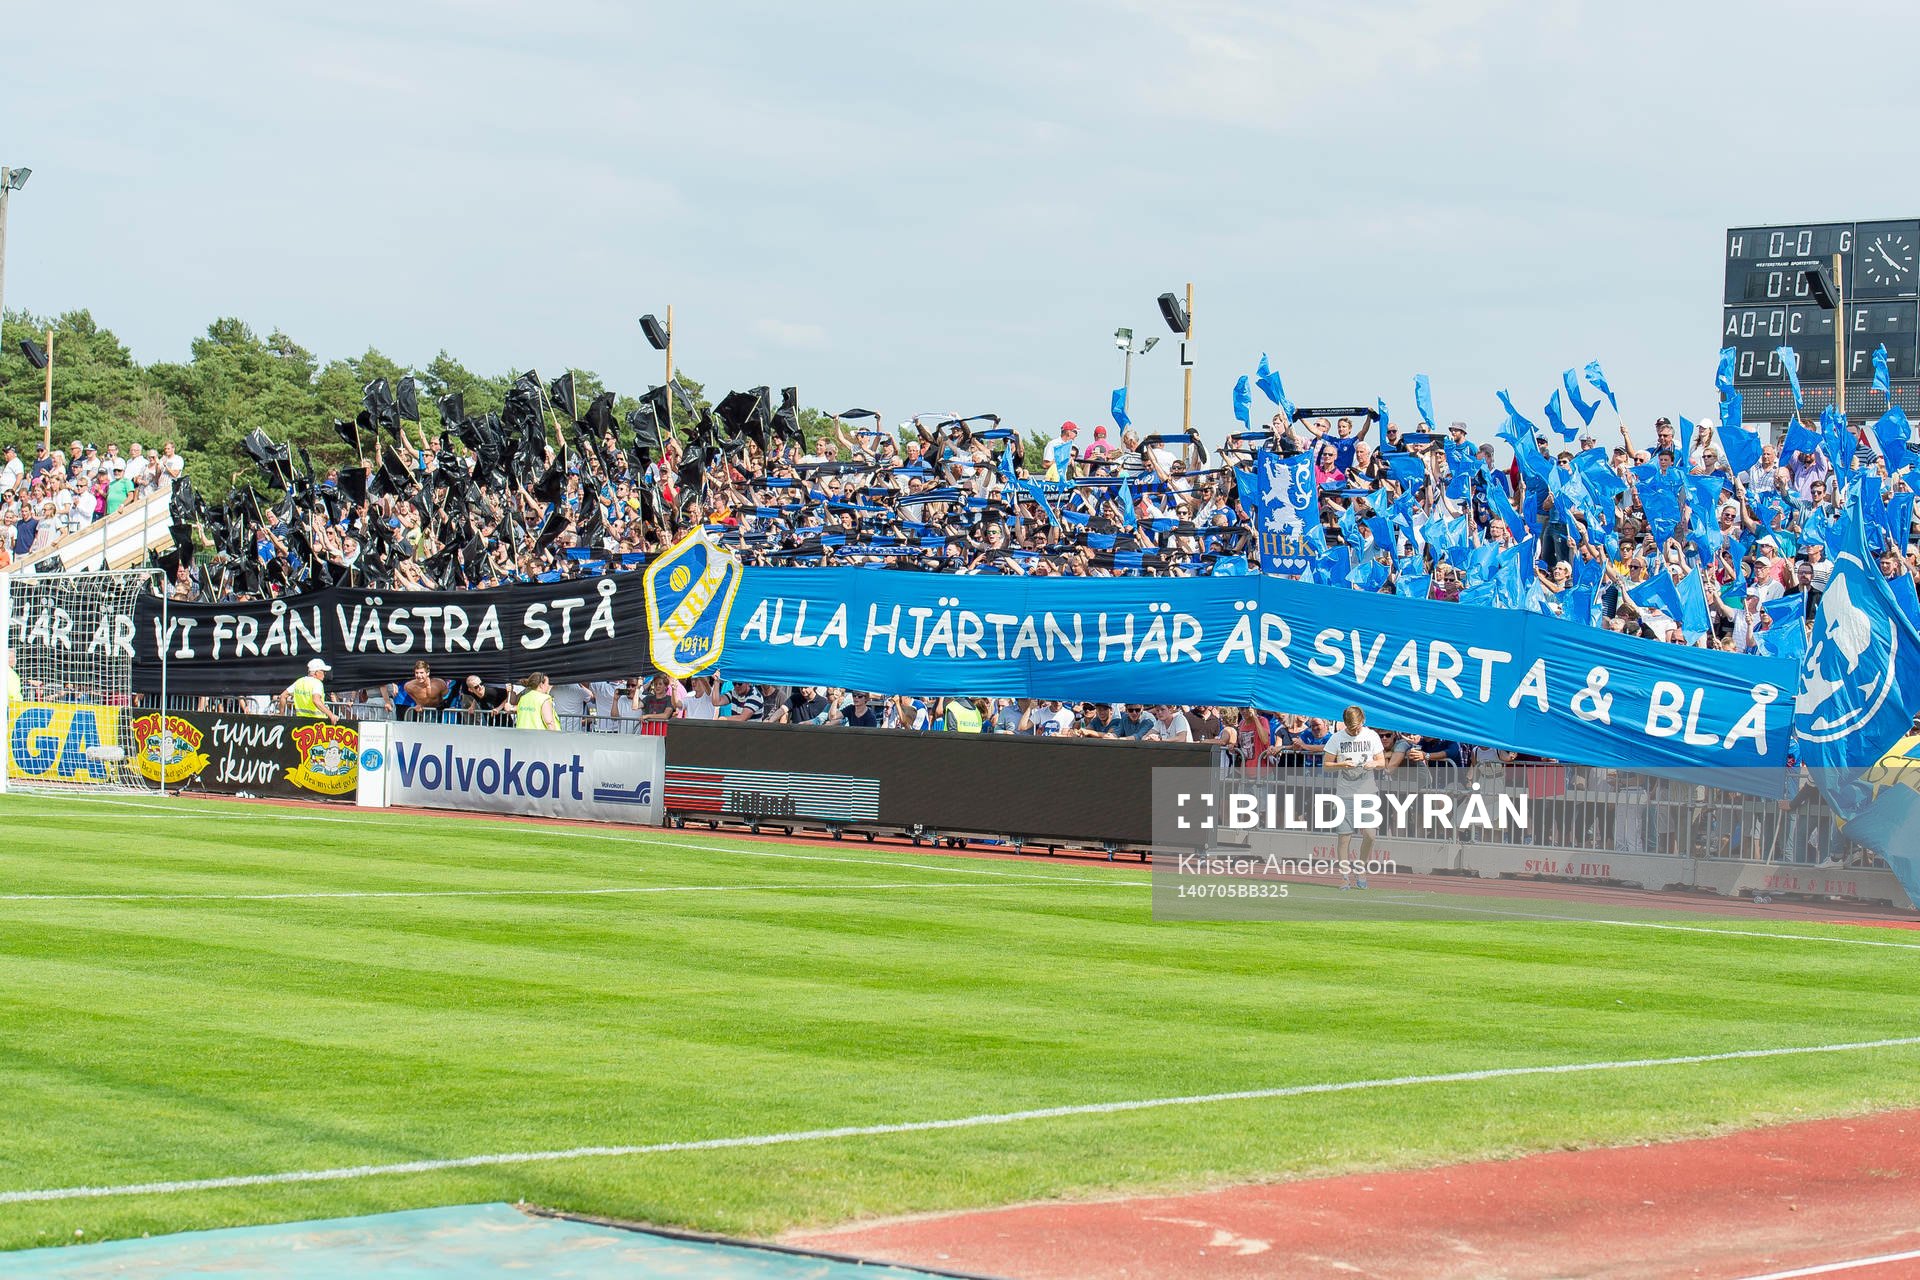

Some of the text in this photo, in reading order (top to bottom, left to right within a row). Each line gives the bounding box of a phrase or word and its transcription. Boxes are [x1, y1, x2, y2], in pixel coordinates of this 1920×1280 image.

[1730, 231, 1851, 258] H 0-0 G
[1725, 315, 1738, 335] A
[1790, 312, 1802, 334] C
[1854, 310, 1868, 331] E
[1852, 350, 1866, 372] F
[1262, 532, 1316, 557] HBK
[88, 604, 136, 657] ÄR
[153, 616, 198, 660] VI
[212, 600, 322, 660] FRÅN
[337, 596, 504, 652] VÄSTRA
[520, 579, 617, 650] STÅ
[741, 598, 847, 649] ALLA
[863, 597, 1082, 662] HJÄRTAN
[1097, 602, 1203, 663] HÄR
[1216, 600, 1292, 669] ÄR
[1570, 666, 1613, 725] &
[1644, 681, 1778, 756] BLÅ
[211, 718, 285, 749] tunna
[1340, 742, 1352, 753] BOB
[216, 740, 280, 784] skivor
[395, 741, 584, 800] Volvokort
[600, 781, 625, 790] Volvokort
[1525, 858, 1610, 876] STÅL & HYR
